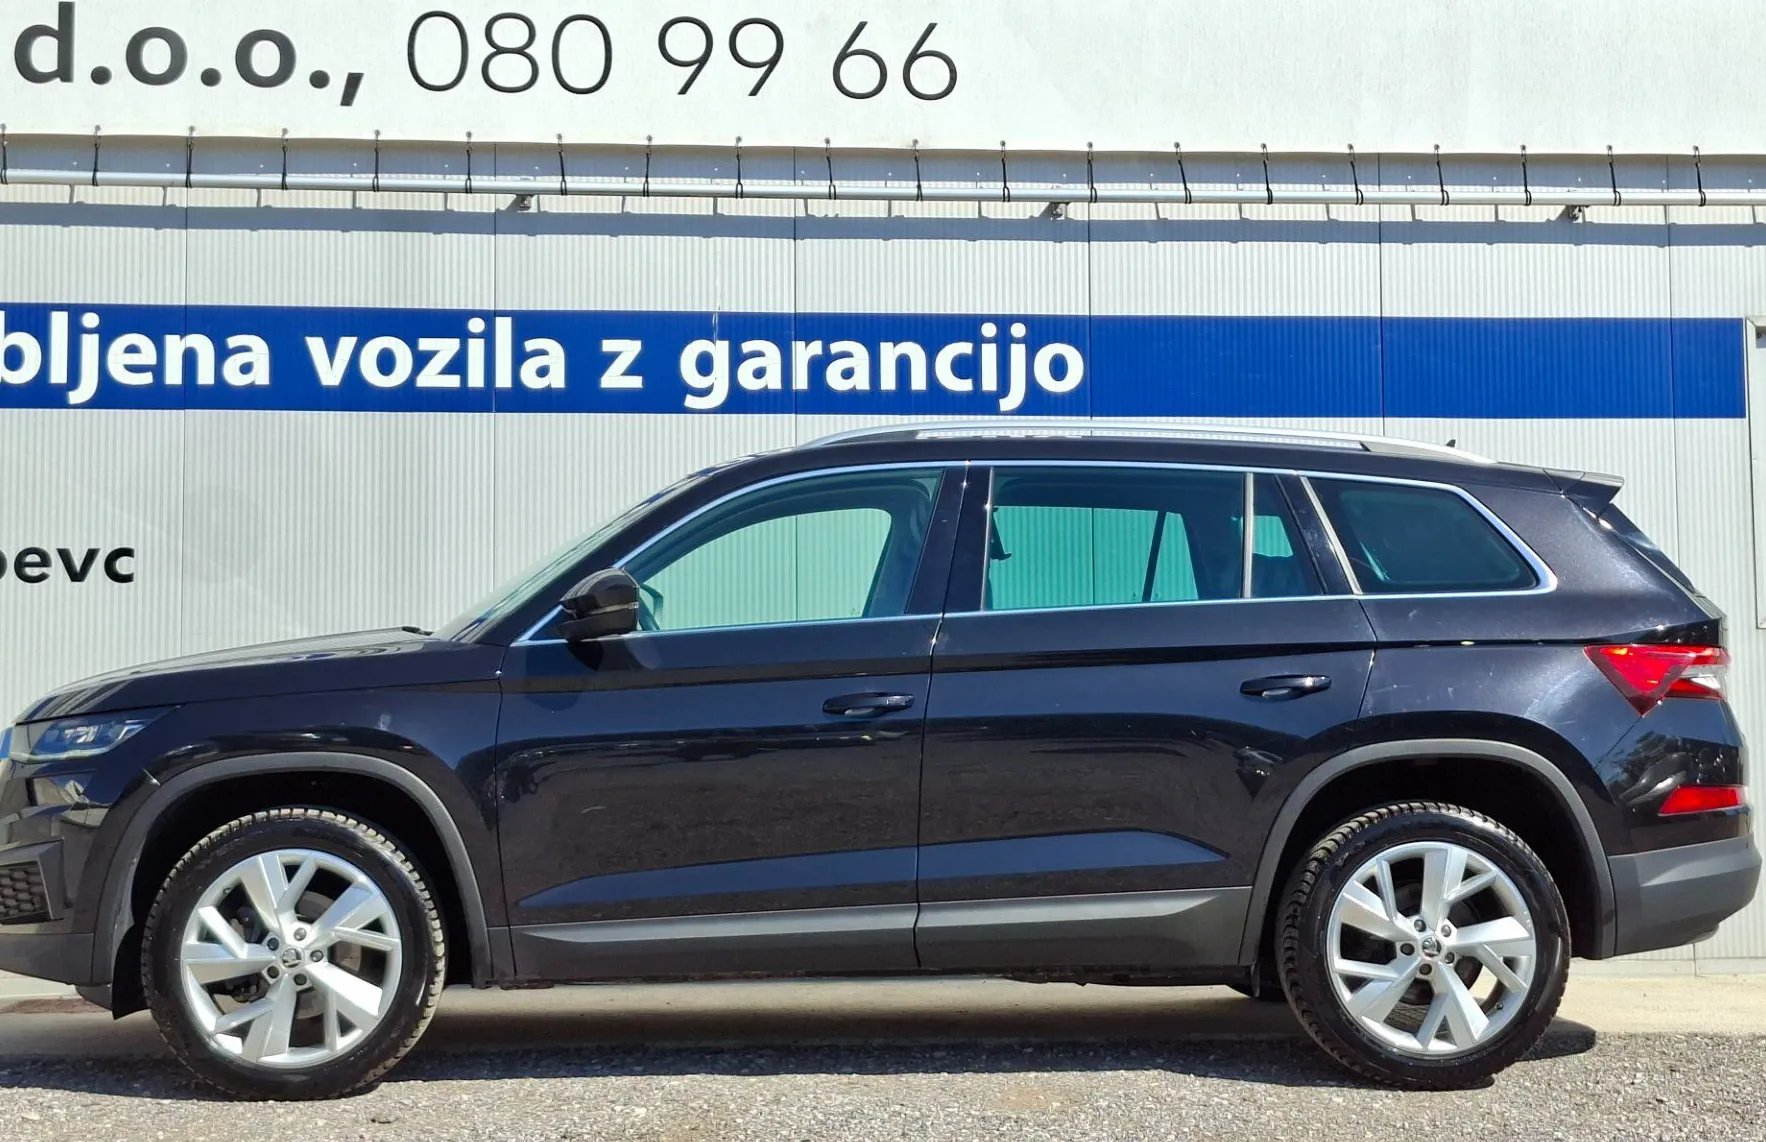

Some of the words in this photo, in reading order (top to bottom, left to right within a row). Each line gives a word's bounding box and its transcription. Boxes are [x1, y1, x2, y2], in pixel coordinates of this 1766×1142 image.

[14, 1, 364, 107] d.o.o.,
[407, 10, 613, 95] 080
[657, 16, 785, 97] 99
[832, 21, 958, 101] 66
[0, 309, 271, 405] bljena
[305, 316, 566, 390] vozila
[600, 339, 643, 389] z
[679, 322, 1085, 412] garancijo
[0, 546, 136, 584] evc
